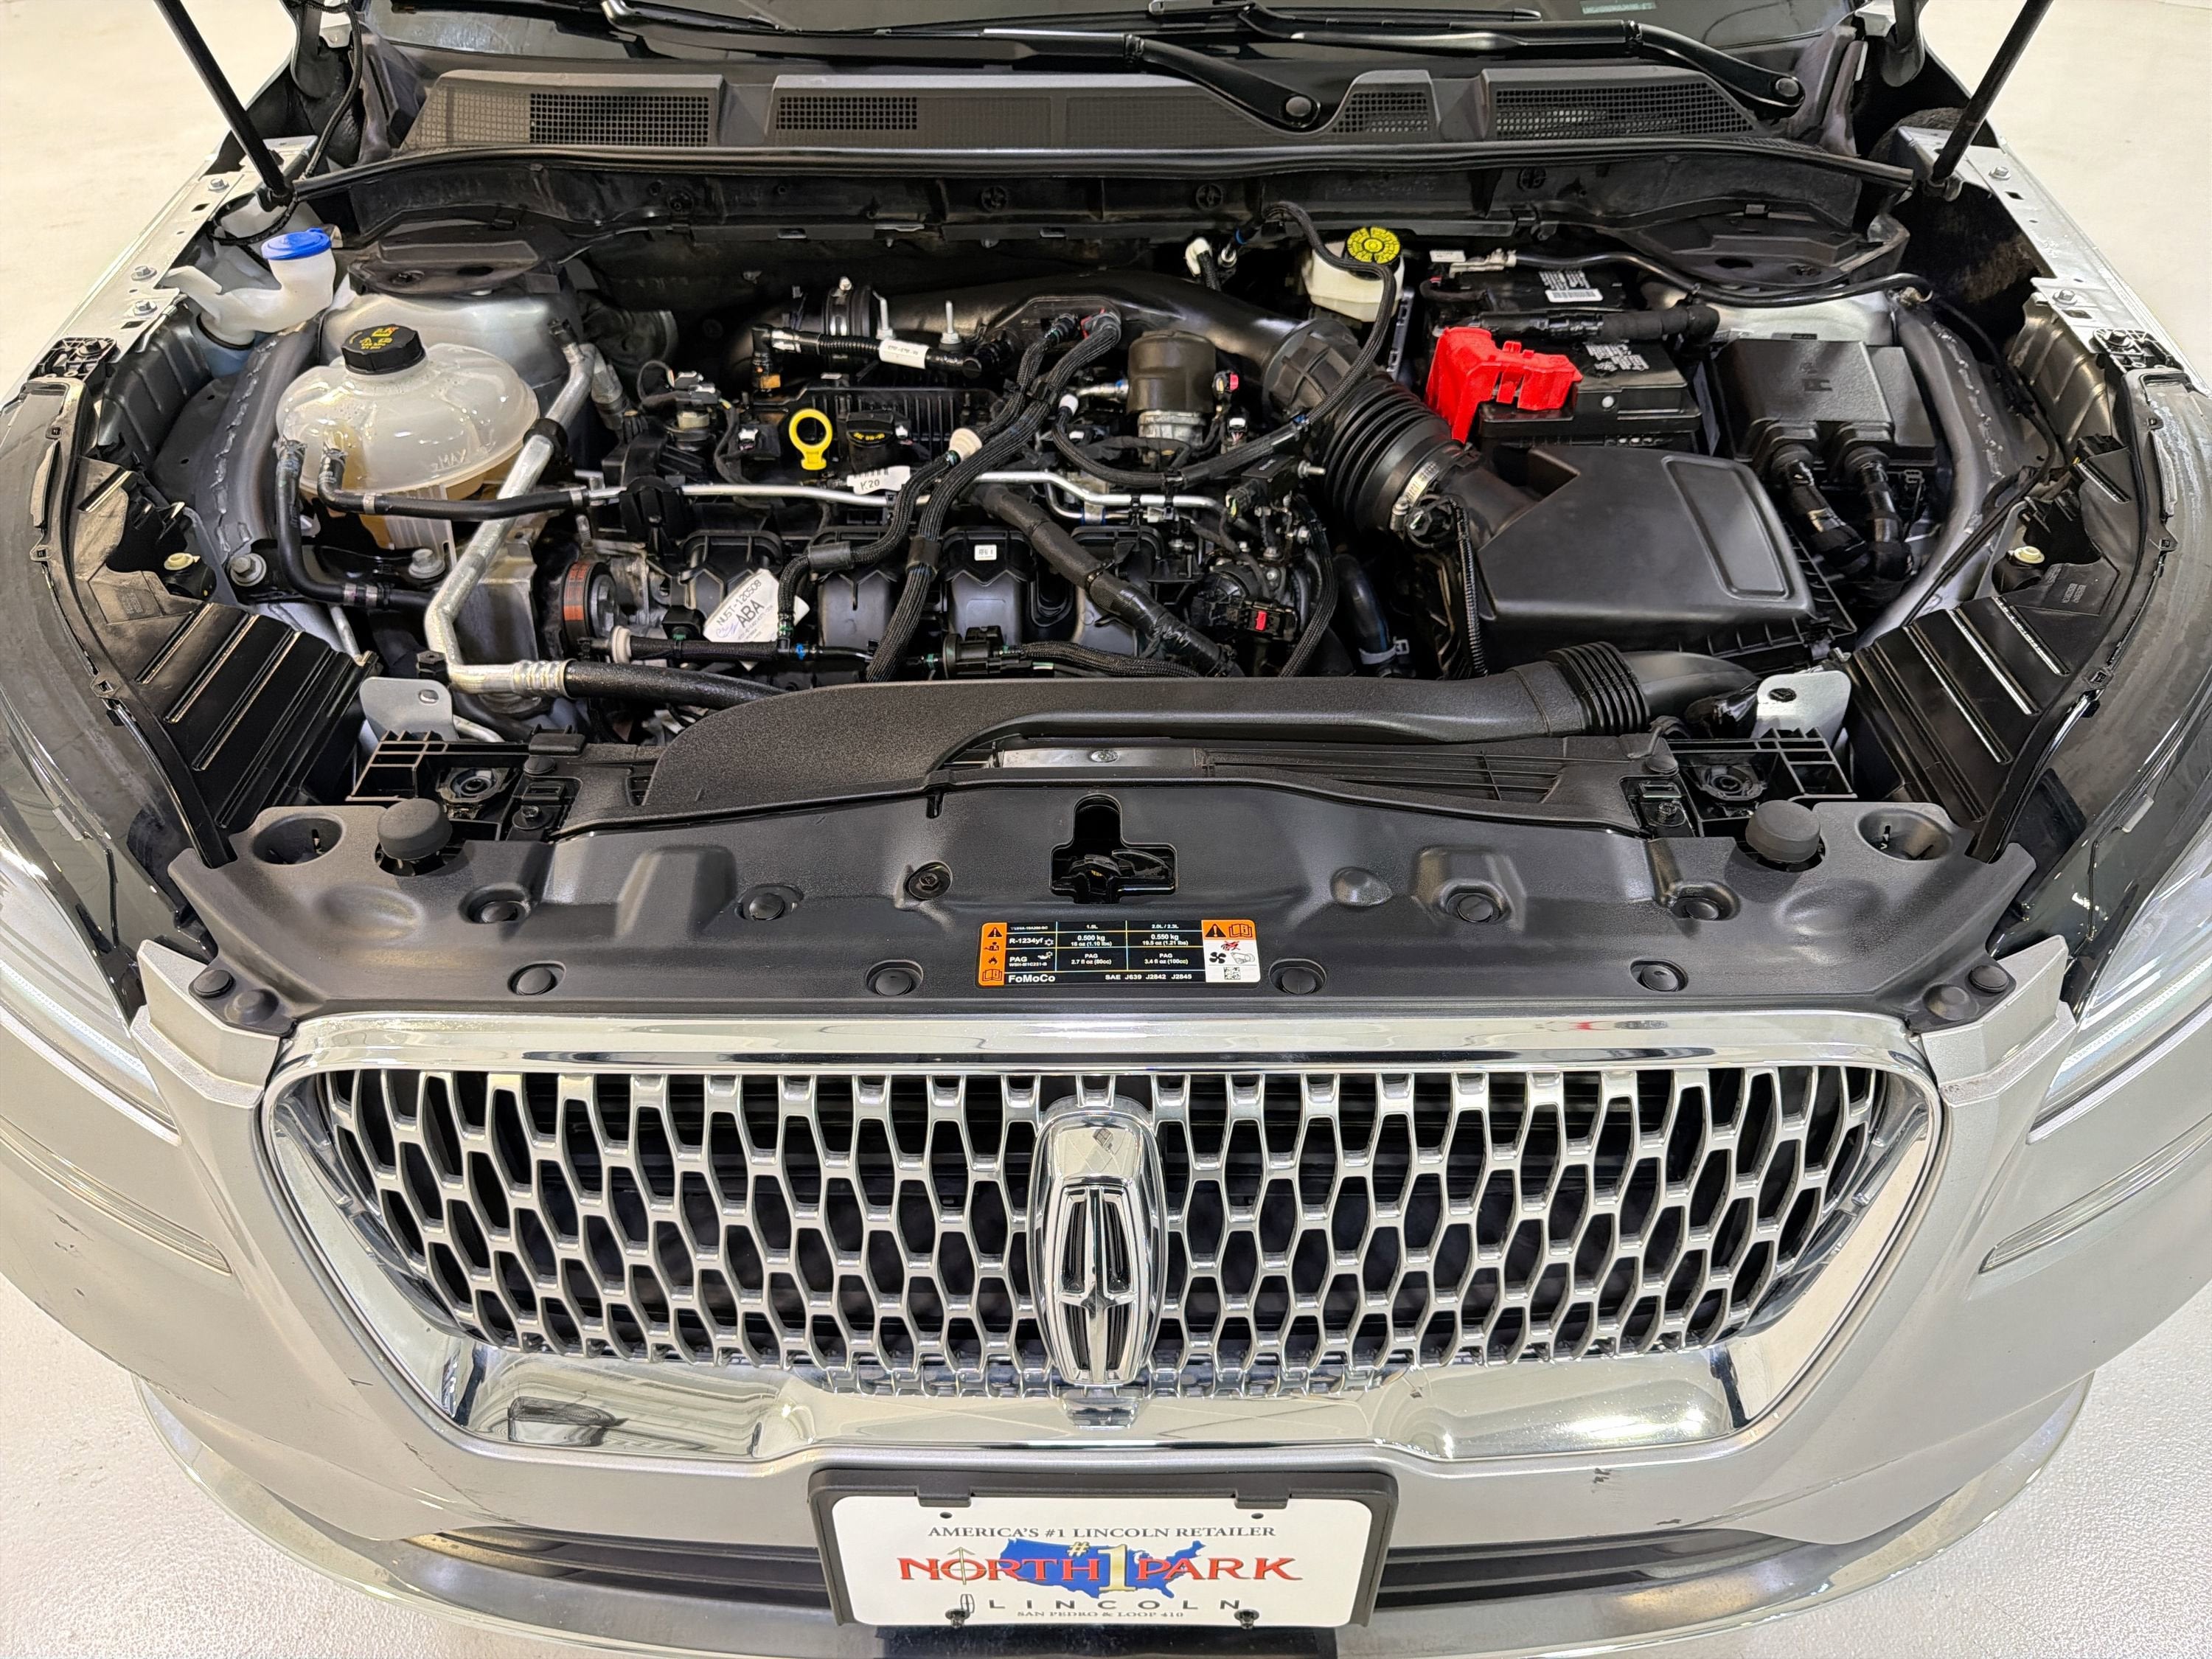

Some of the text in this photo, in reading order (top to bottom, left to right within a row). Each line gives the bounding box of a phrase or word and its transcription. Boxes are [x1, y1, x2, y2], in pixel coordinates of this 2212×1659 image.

[860, 479, 880, 490] K20
[736, 599, 765, 628] ABA
[1009, 974, 1055, 983] FoMoCo
[928, 1527, 1276, 1538] AMERICA'S #1 LINCOLN RETAILER
[897, 1557, 1304, 1581] NORTH PARK
[990, 1600, 1240, 1610] LINCOLN
